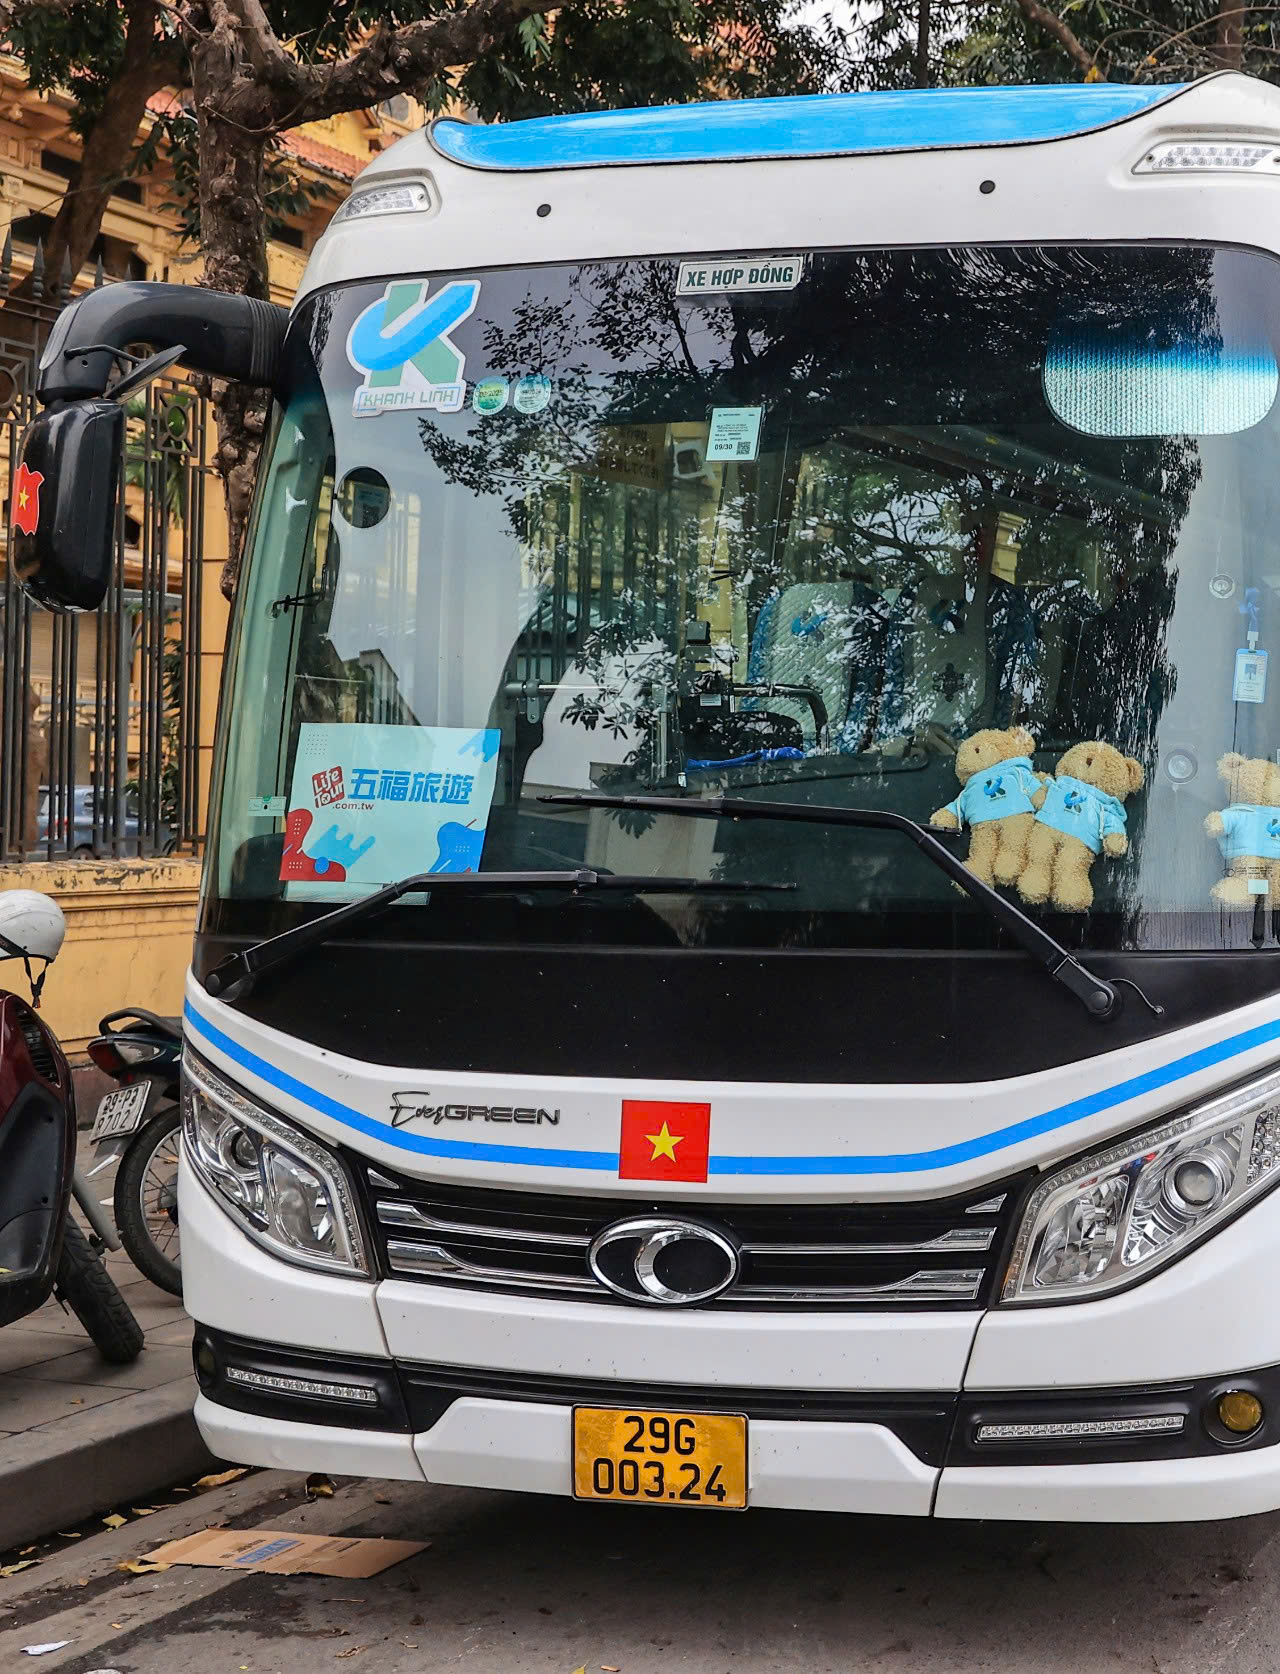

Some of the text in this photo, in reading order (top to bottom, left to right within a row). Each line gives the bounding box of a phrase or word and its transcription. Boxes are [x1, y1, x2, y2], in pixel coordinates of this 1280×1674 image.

[686, 262, 794, 288] XE HỢP ĐỒNG
[363, 388, 454, 407] KHANH LINH
[714, 443, 733, 451] 09/30
[313, 767, 341, 793] Life
[347, 768, 475, 805] 五福旅遊
[314, 782, 346, 809] Tour
[332, 802, 375, 811] .com.tw
[389, 1091, 561, 1128] EverGREEN
[623, 1415, 696, 1456] 29G
[593, 1457, 727, 1502] 003.24
